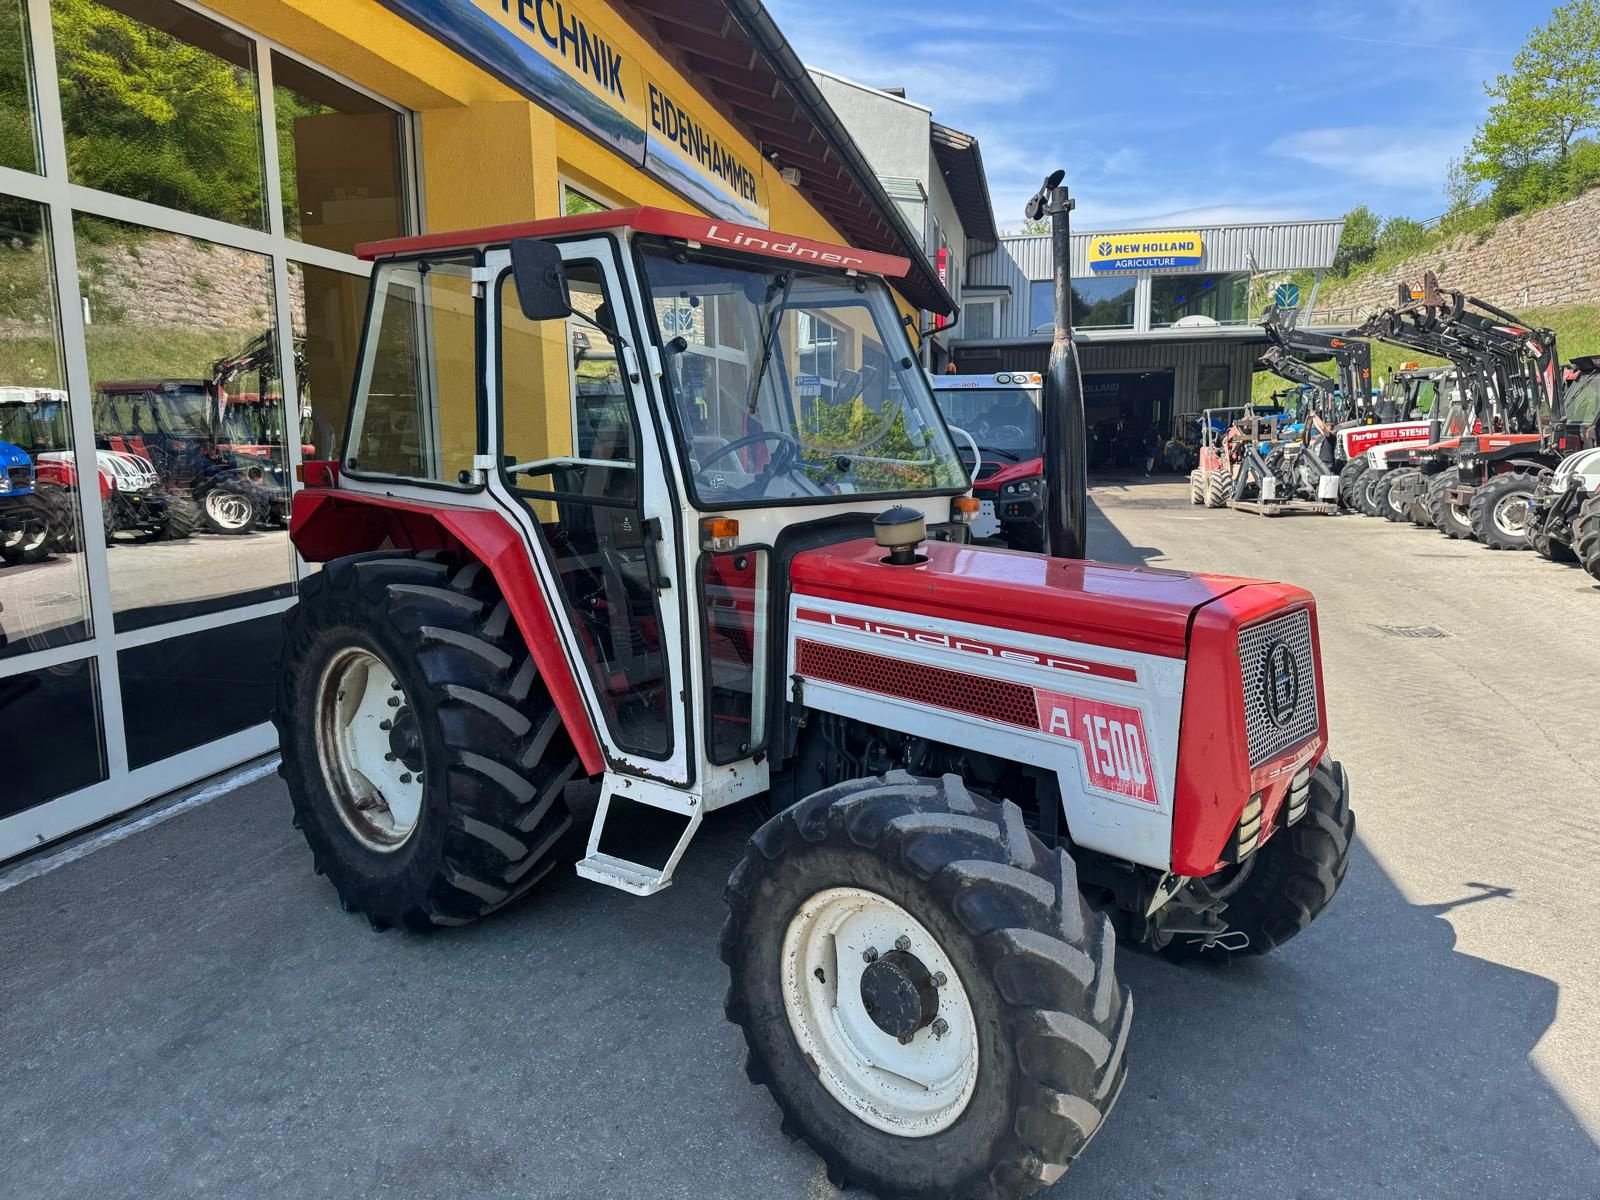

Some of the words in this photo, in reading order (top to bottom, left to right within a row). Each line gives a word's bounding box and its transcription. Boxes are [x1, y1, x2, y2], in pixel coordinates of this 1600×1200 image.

[501, 0, 626, 103] ECHNIK
[648, 82, 758, 204] EIDENHAMMER
[706, 225, 863, 265] Lindner
[1115, 244, 1140, 254] NEW
[1143, 241, 1194, 253] HOLLAND
[1115, 258, 1175, 269] AGRICULTURE
[1351, 432, 1379, 441] Turbo
[1398, 427, 1429, 437] STEYR
[830, 613, 1090, 671] Lindner
[1048, 706, 1072, 737] A
[1082, 713, 1148, 786] 1500
